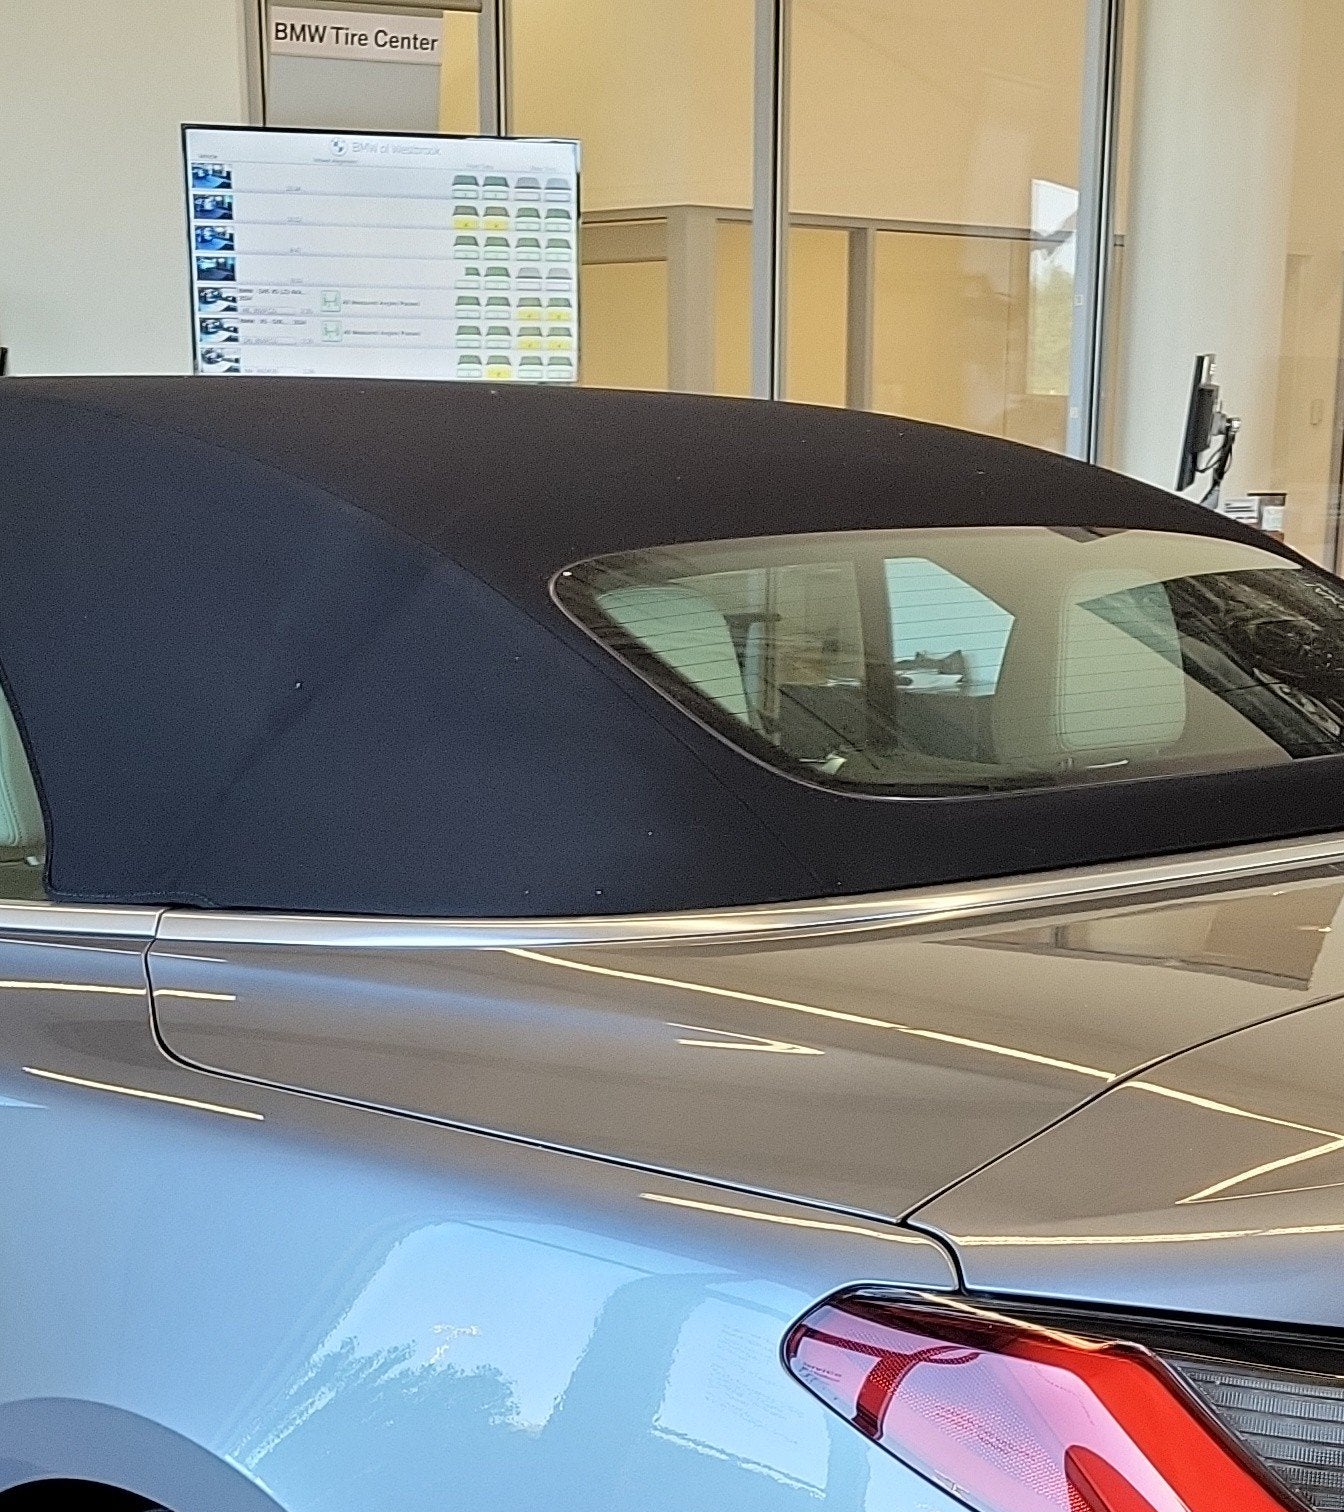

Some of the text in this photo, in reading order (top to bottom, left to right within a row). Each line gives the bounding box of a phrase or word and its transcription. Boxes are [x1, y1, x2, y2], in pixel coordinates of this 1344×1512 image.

[274, 22, 438, 51] BMW Tire Center
